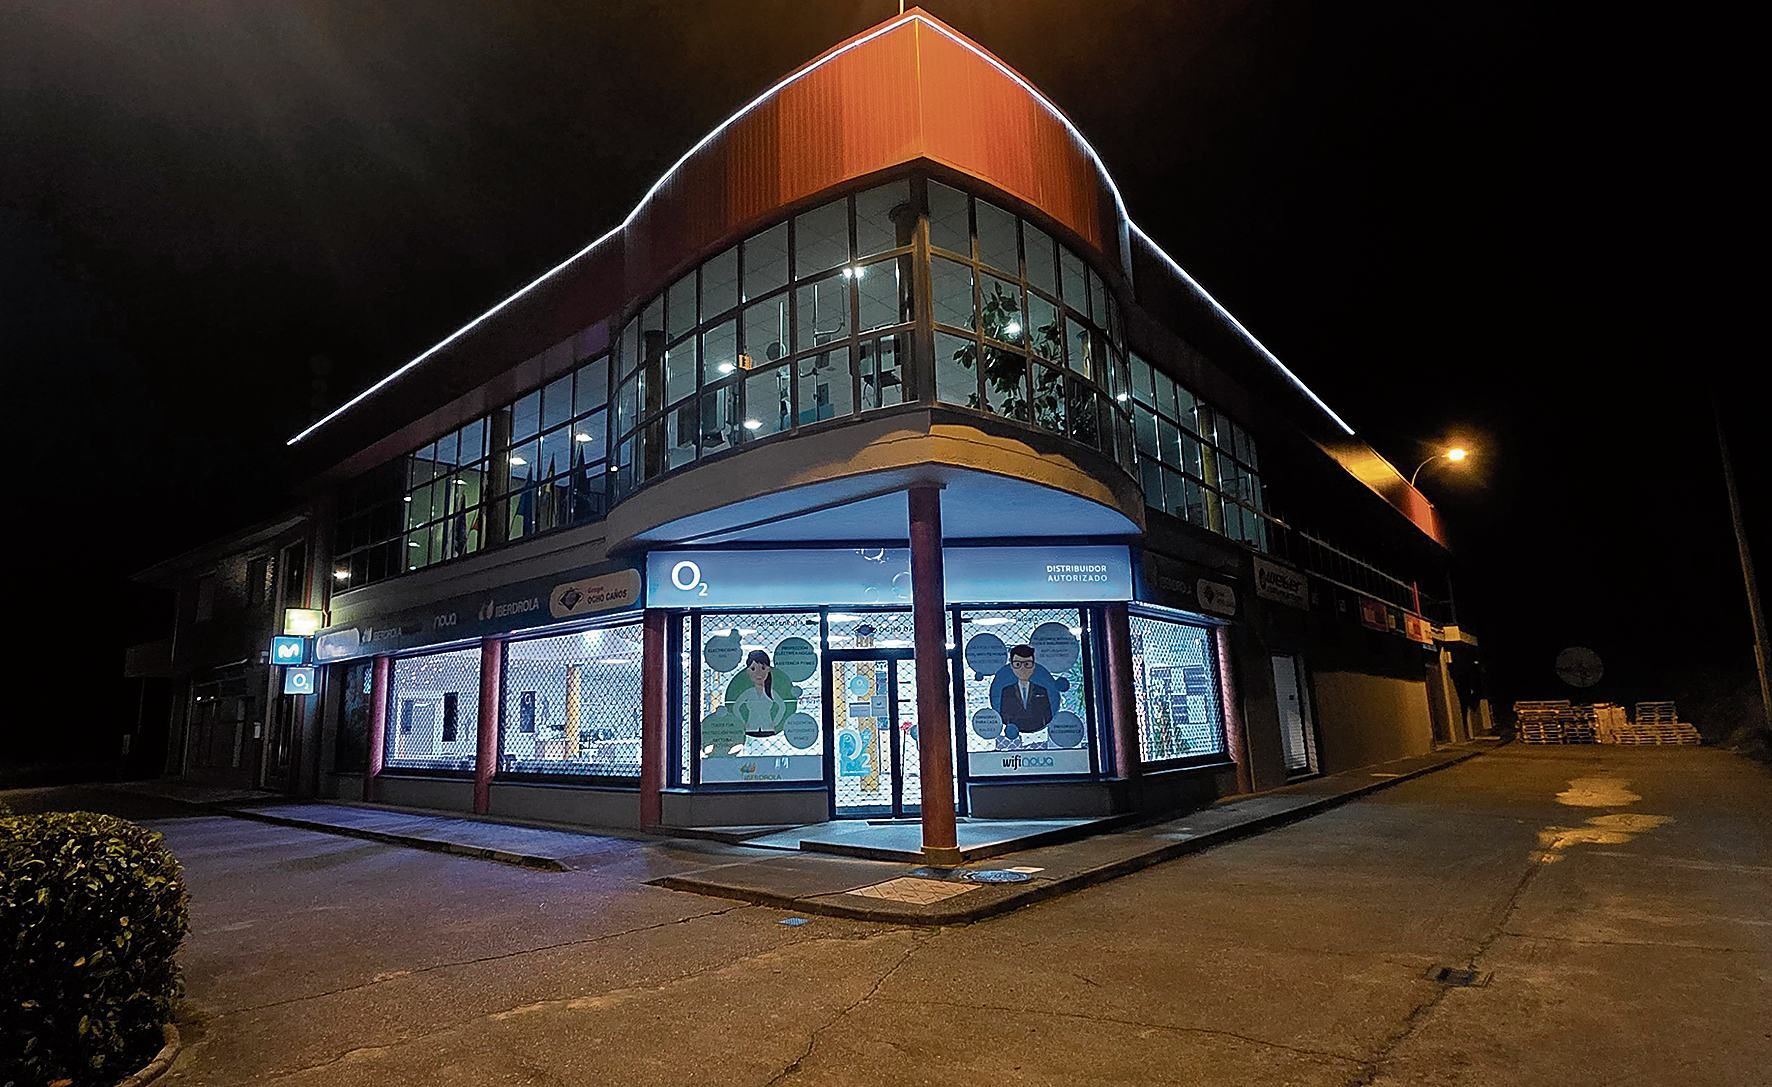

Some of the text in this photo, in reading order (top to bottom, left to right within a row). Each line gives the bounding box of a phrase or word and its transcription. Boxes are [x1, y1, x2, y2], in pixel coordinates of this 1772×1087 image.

[1046, 565, 1107, 573] DISTRIBUIDOR
[671, 560, 709, 597] O2
[1047, 574, 1108, 582] AUTORIZADO
[587, 594, 605, 605] OCHO
[495, 598, 540, 618] IBERDROLA
